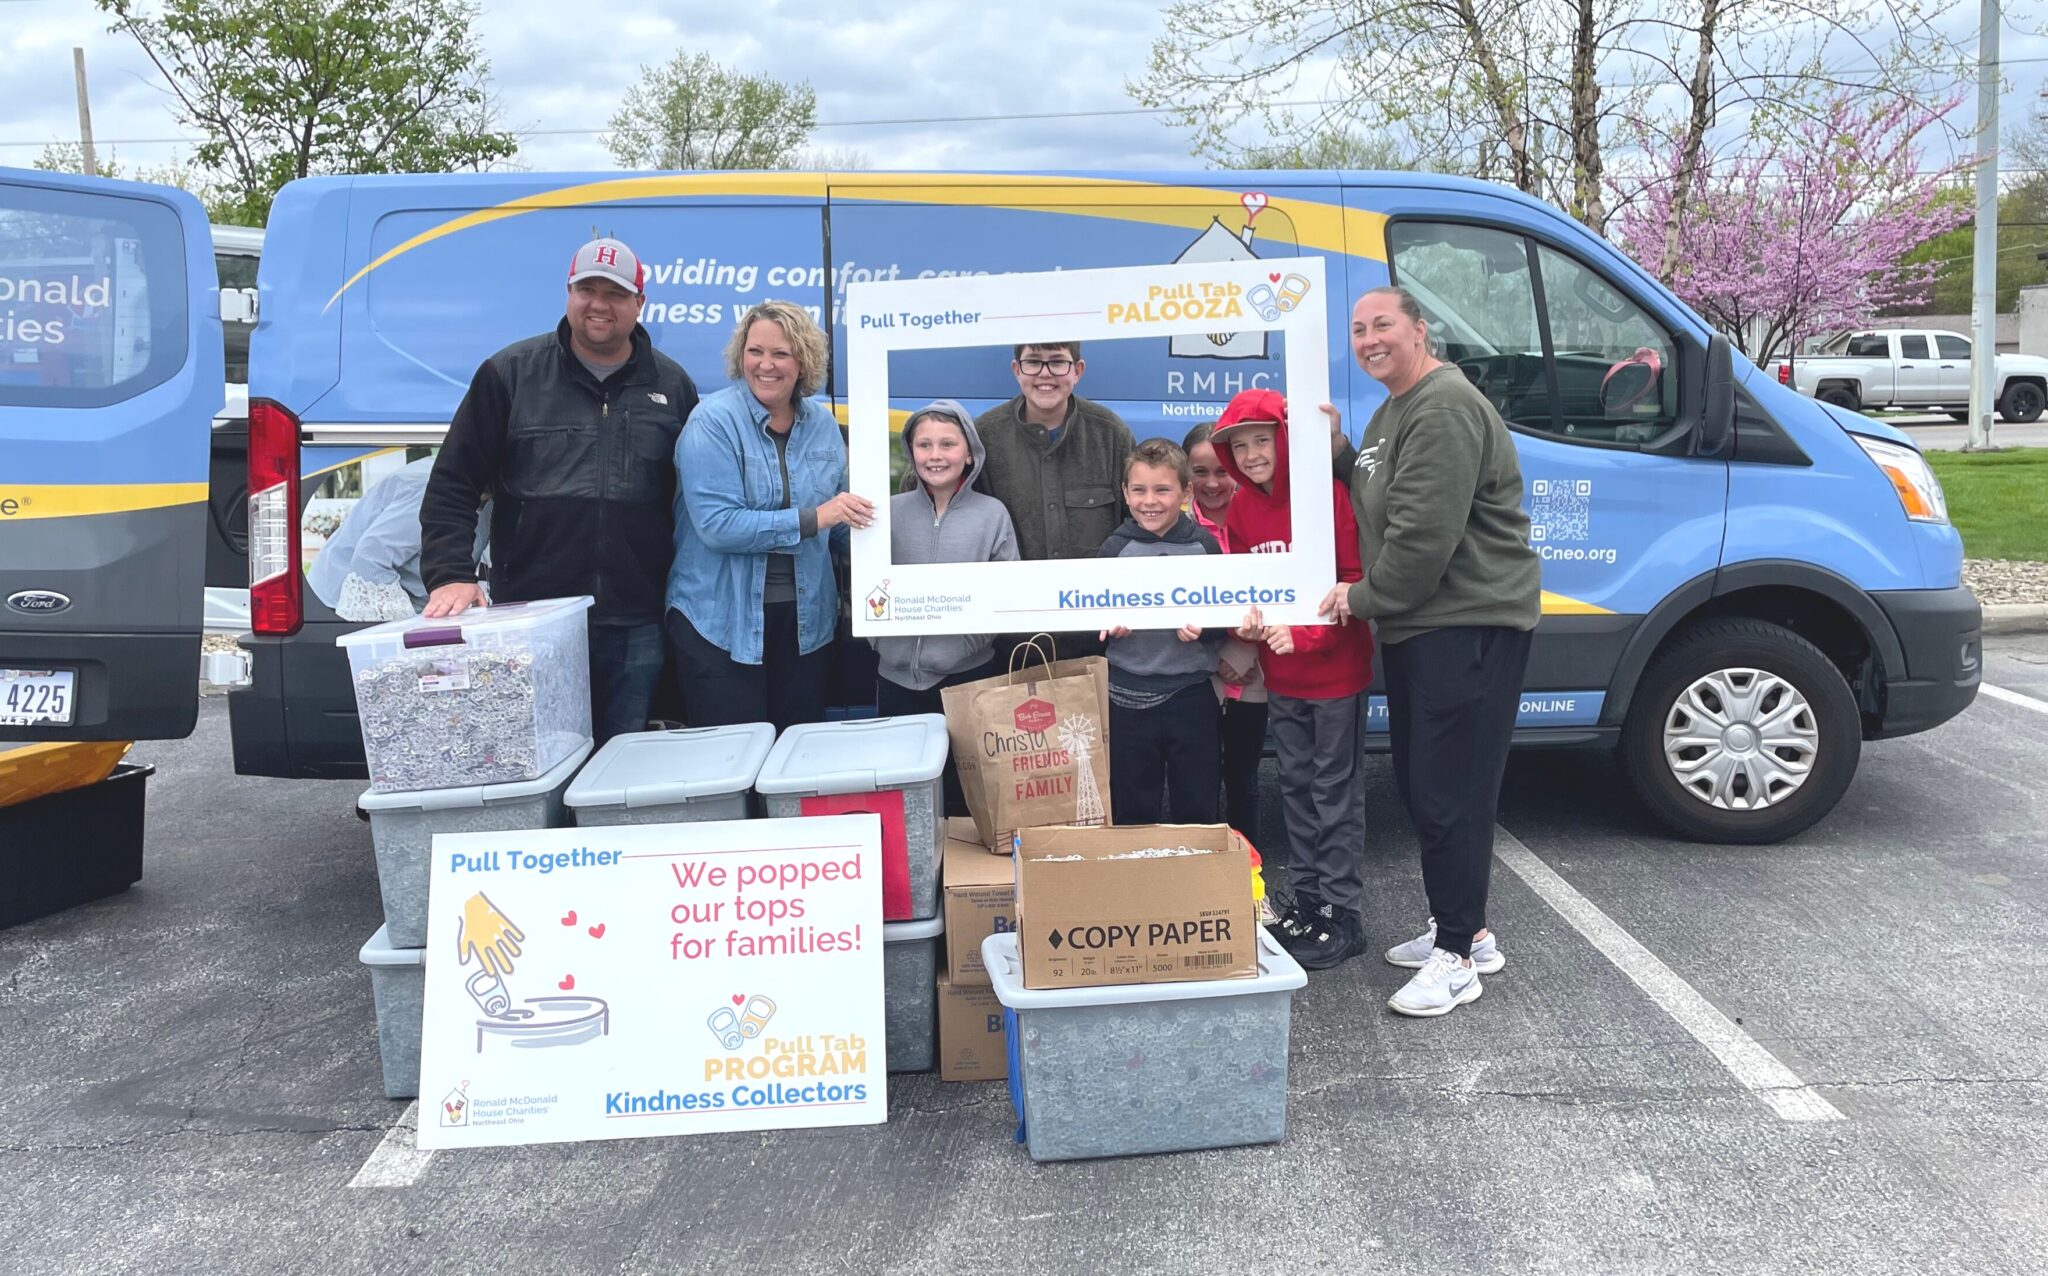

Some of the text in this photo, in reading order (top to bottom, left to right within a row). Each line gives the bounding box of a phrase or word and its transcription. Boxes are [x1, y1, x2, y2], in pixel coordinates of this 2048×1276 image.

[594, 244, 619, 268] H
[642, 257, 758, 293] oviding
[0, 274, 111, 308] onald
[1147, 281, 1243, 301] Pull Tab
[860, 310, 982, 329] Pull Together
[1107, 298, 1243, 324] PALOOZA
[0, 309, 65, 344] ies
[1162, 402, 1227, 416] Northea
[1528, 545, 1617, 564] Cneo.org
[20, 594, 56, 608] Ford
[894, 594, 972, 605] Ronald McDonald
[894, 604, 963, 614] House Charities
[1058, 585, 1296, 609] Kindness Collectors
[6, 684, 66, 714] 4225
[1519, 699, 1576, 713] ONLINE
[983, 728, 1051, 768] Christy
[1012, 750, 1070, 772] FRIENDS
[1015, 776, 1072, 801] FAMILY
[450, 846, 623, 874] Pull Together
[671, 853, 862, 893] We popped
[671, 895, 805, 926] our tops
[671, 924, 861, 960] for families!
[1068, 918, 1232, 949] COPY PAPER
[1053, 969, 1063, 977] 92
[1152, 964, 1173, 972] 5000
[764, 1033, 866, 1055] Pull Tab
[704, 1051, 867, 1082] PROGRAM
[473, 1094, 558, 1108] Ronald McDonald
[606, 1081, 867, 1115] Kindness Collectors
[473, 1109, 504, 1118] House
